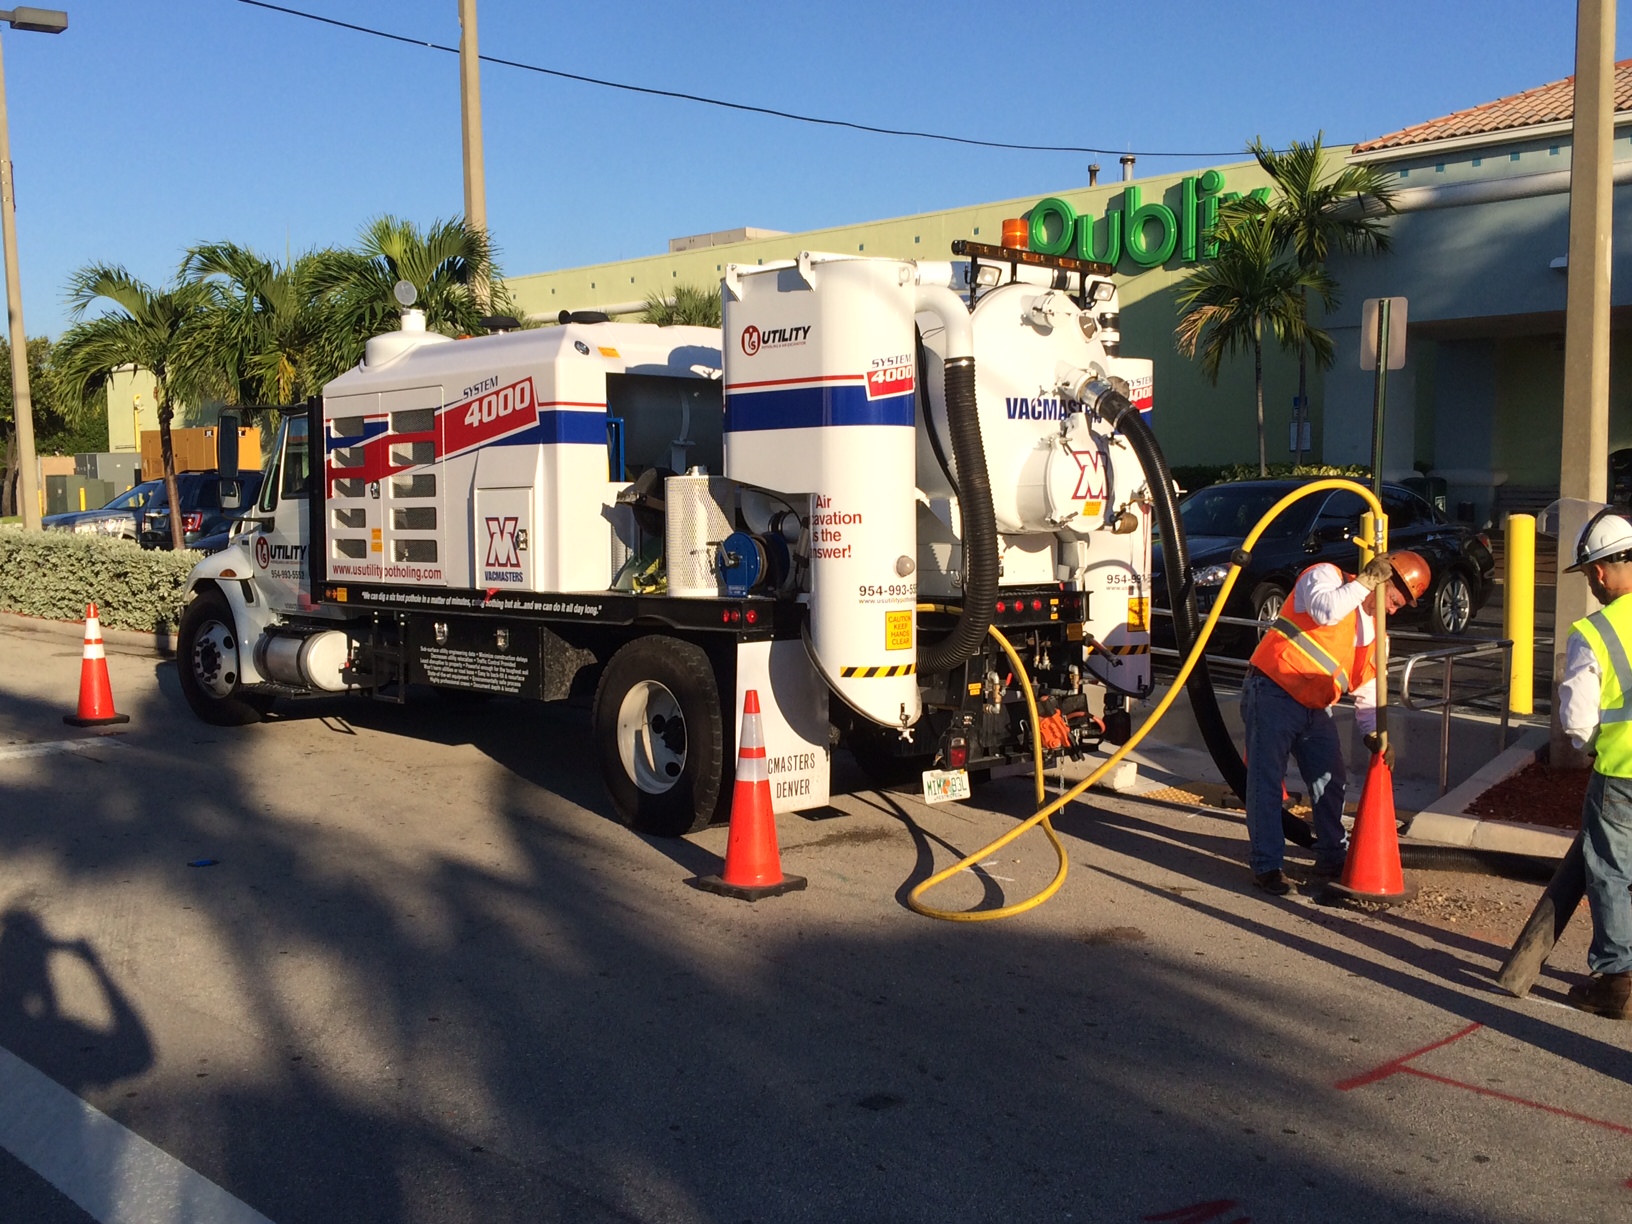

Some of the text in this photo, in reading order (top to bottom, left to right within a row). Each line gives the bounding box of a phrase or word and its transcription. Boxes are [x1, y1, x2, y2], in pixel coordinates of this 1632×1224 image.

[762, 325, 811, 345] UTILITY
[870, 365, 913, 384] 4000
[463, 375, 498, 399] SYSTEM
[464, 380, 531, 428] 4000
[815, 494, 832, 509] Air
[821, 528, 842, 543] the
[270, 544, 308, 560] UTILITY
[810, 544, 852, 559] nswer!
[484, 571, 524, 583] VACMASTERS
[504, 599, 514, 609] but
[534, 602, 542, 610] we
[542, 603, 553, 611] can
[553, 602, 561, 612] do
[560, 602, 566, 613] it
[565, 602, 574, 613] all
[573, 603, 585, 616] day
[893, 622, 908, 630] KEEP
[768, 752, 816, 775] CMASTERS
[776, 778, 810, 799] DENVER
